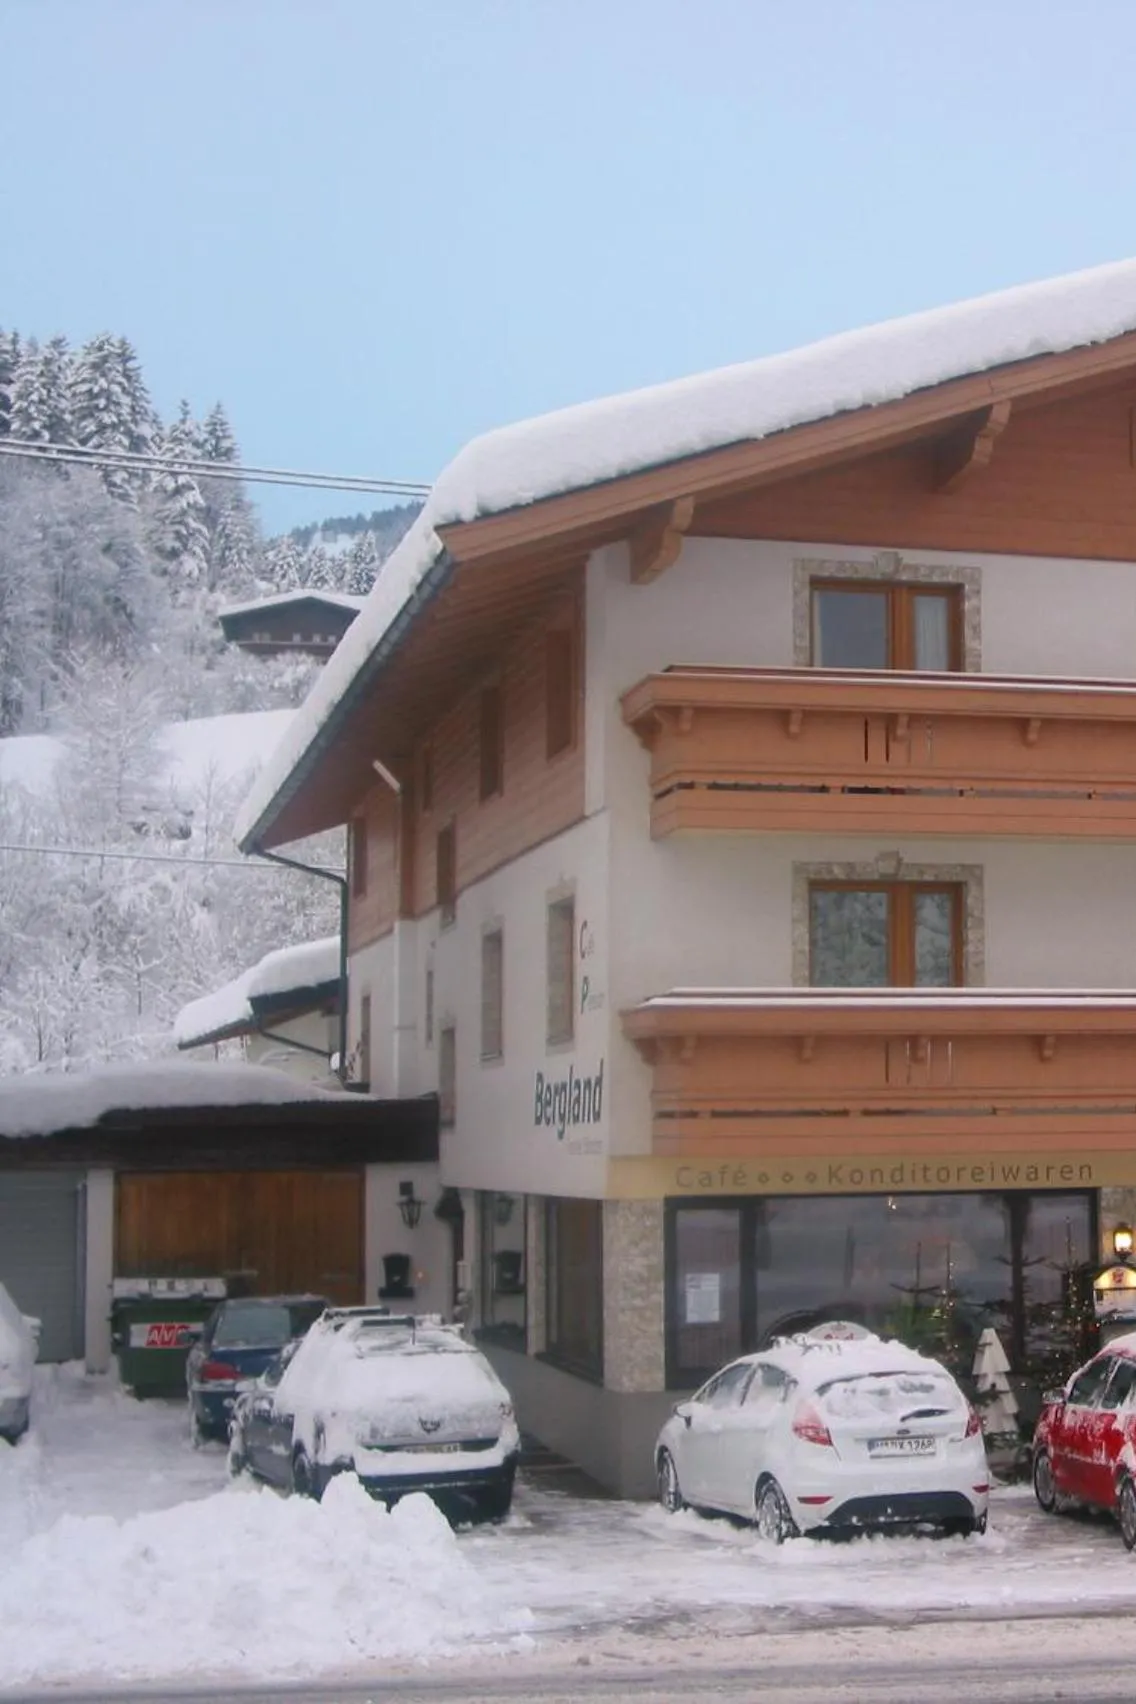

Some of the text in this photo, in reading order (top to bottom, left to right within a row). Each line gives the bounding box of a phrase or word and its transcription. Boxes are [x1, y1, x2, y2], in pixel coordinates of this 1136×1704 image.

[534, 1057, 604, 1141] Bergland
[674, 1160, 1093, 1188] Café Konditoreiwaren
